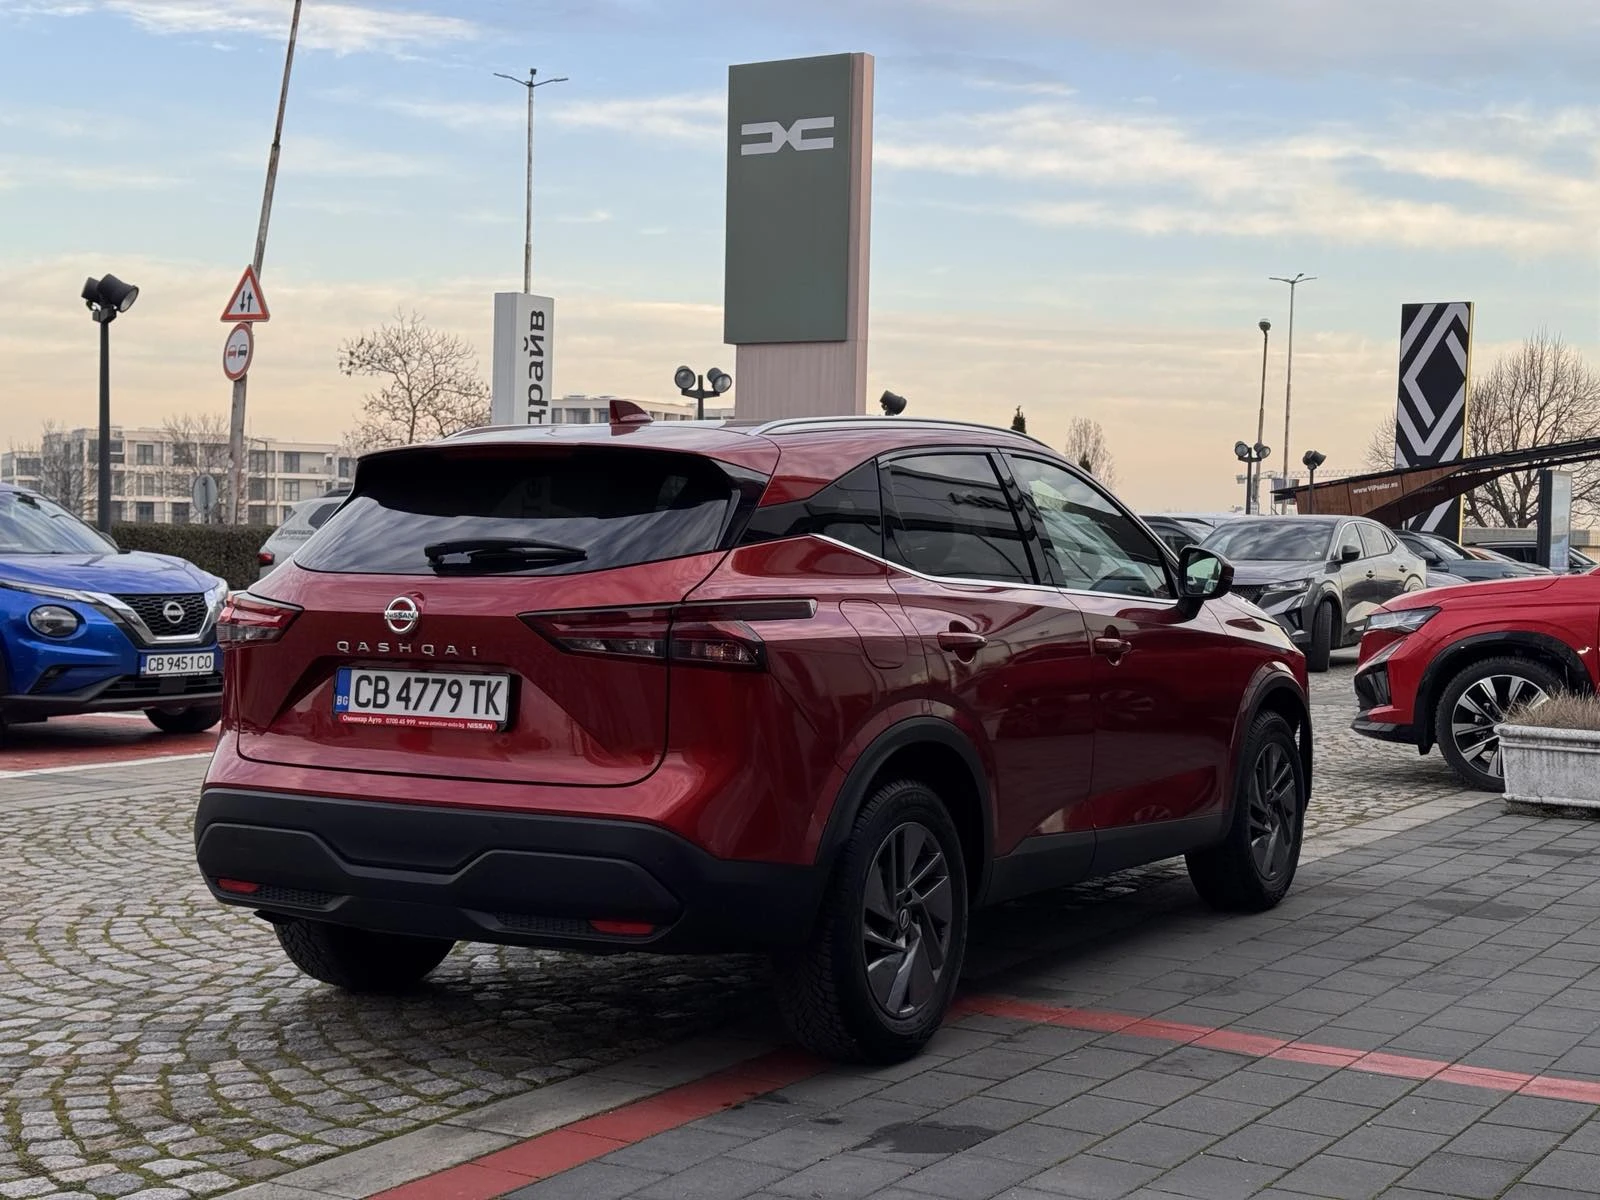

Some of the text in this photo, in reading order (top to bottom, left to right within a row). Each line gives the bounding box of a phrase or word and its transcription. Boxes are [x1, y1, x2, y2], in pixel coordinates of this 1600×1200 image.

[386, 611, 415, 620] NISSAN
[148, 657, 165, 672] CB
[167, 656, 194, 671] 9451
[336, 695, 349, 706] BG
[354, 674, 503, 716] CB 4779 TK
[406, 718, 416, 726] 999
[466, 722, 493, 730] NISSAN
